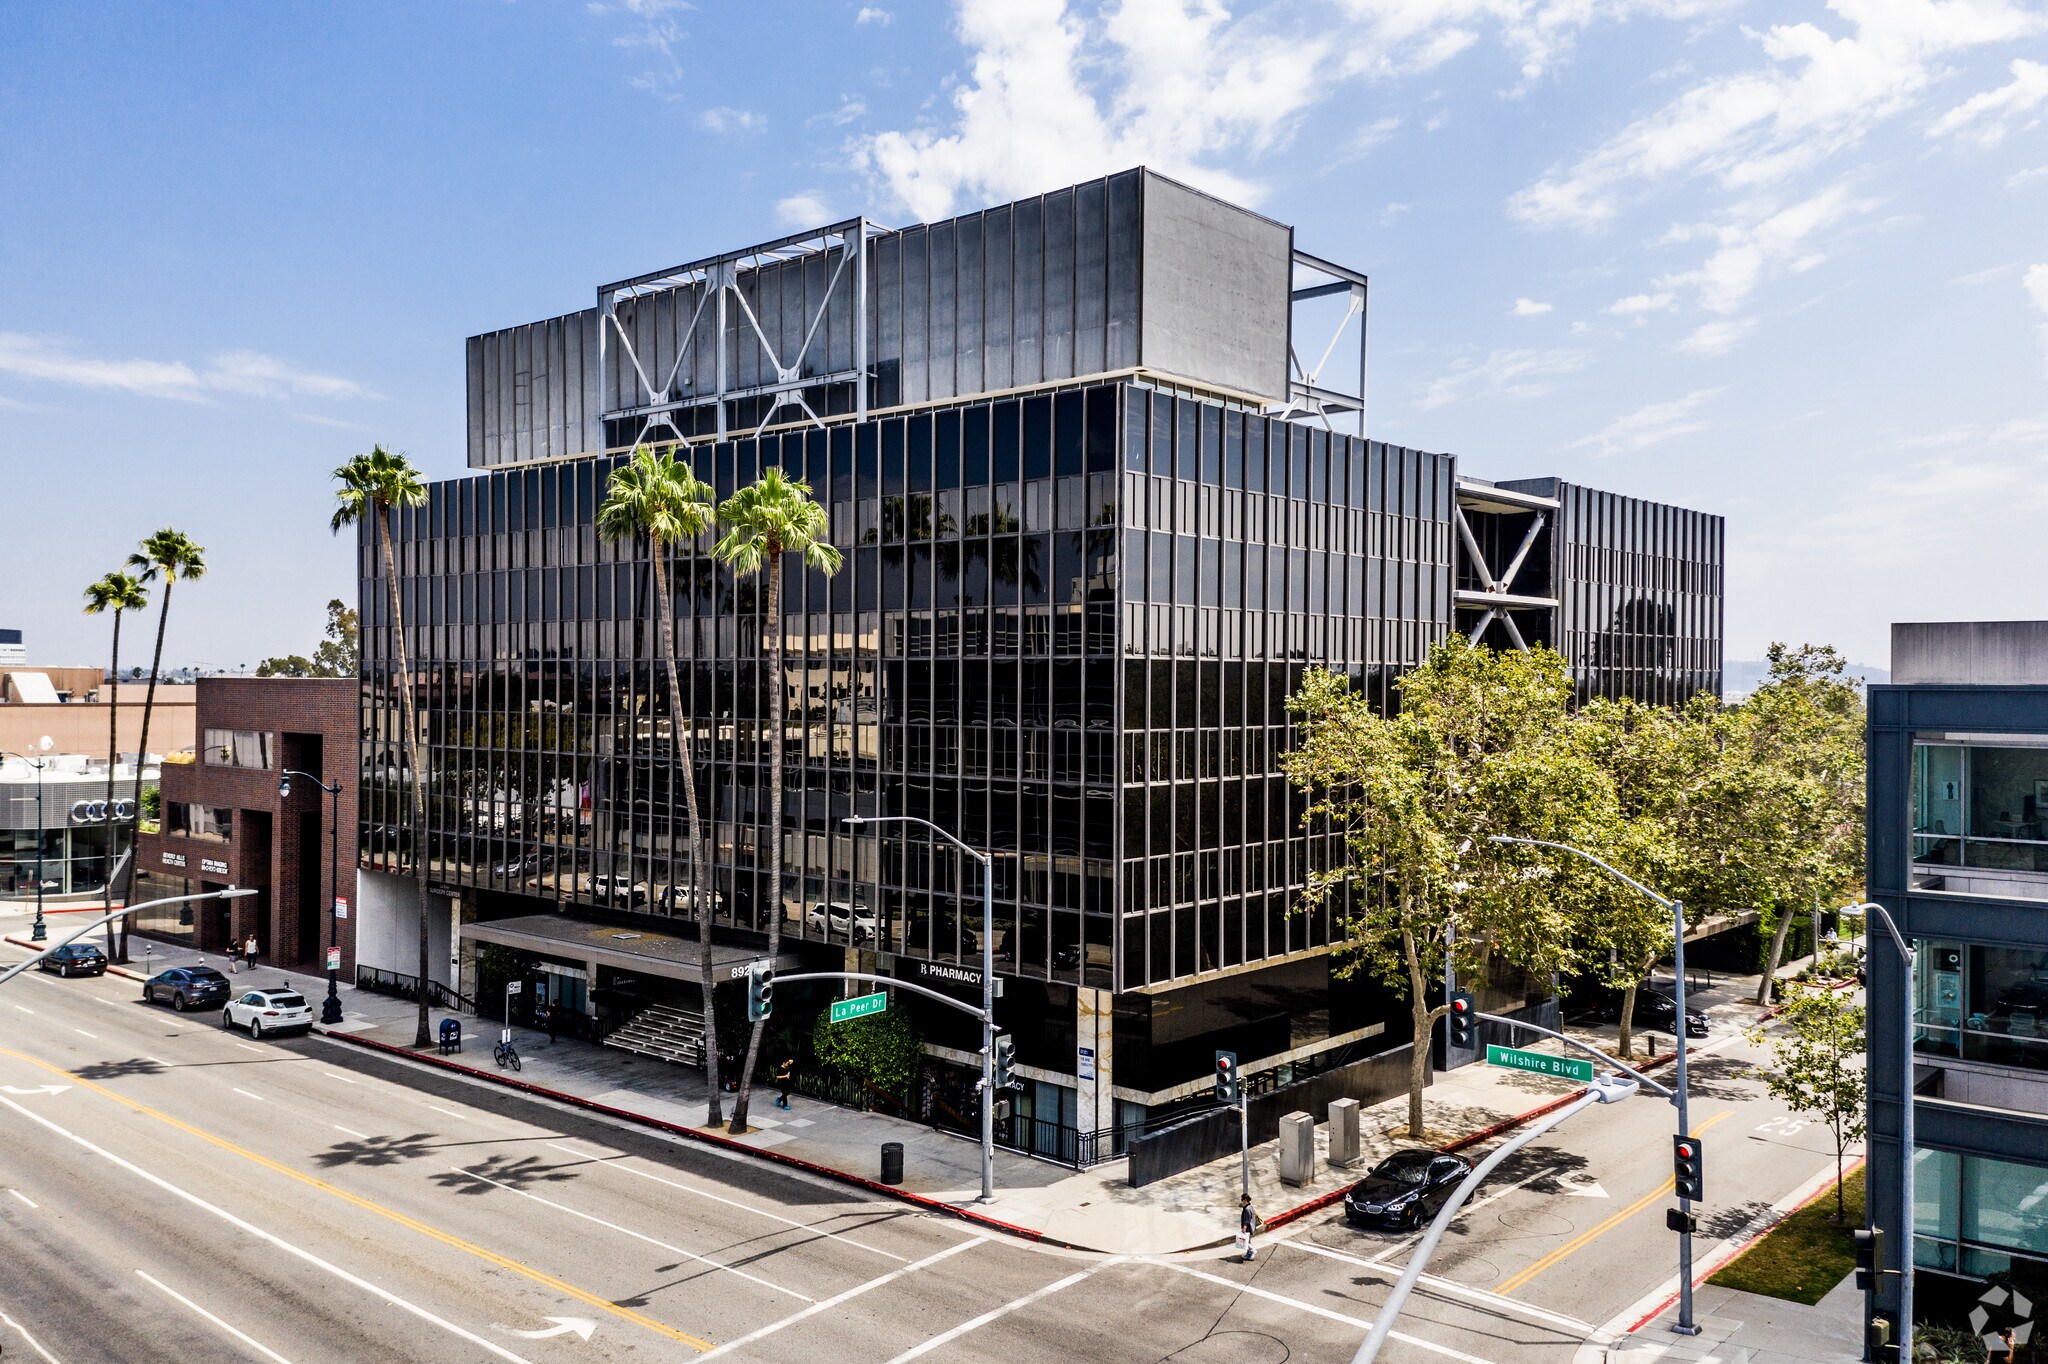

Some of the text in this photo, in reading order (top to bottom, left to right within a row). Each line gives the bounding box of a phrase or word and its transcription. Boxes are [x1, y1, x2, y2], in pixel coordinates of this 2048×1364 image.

[445, 890, 461, 898] CENTER
[731, 965, 750, 978] 892
[929, 965, 982, 984] PHARMACY
[835, 999, 882, 1018] La Peer Dr
[1500, 1051, 1579, 1076] Wilshire Blvd
[1754, 1116, 1811, 1136] 25
